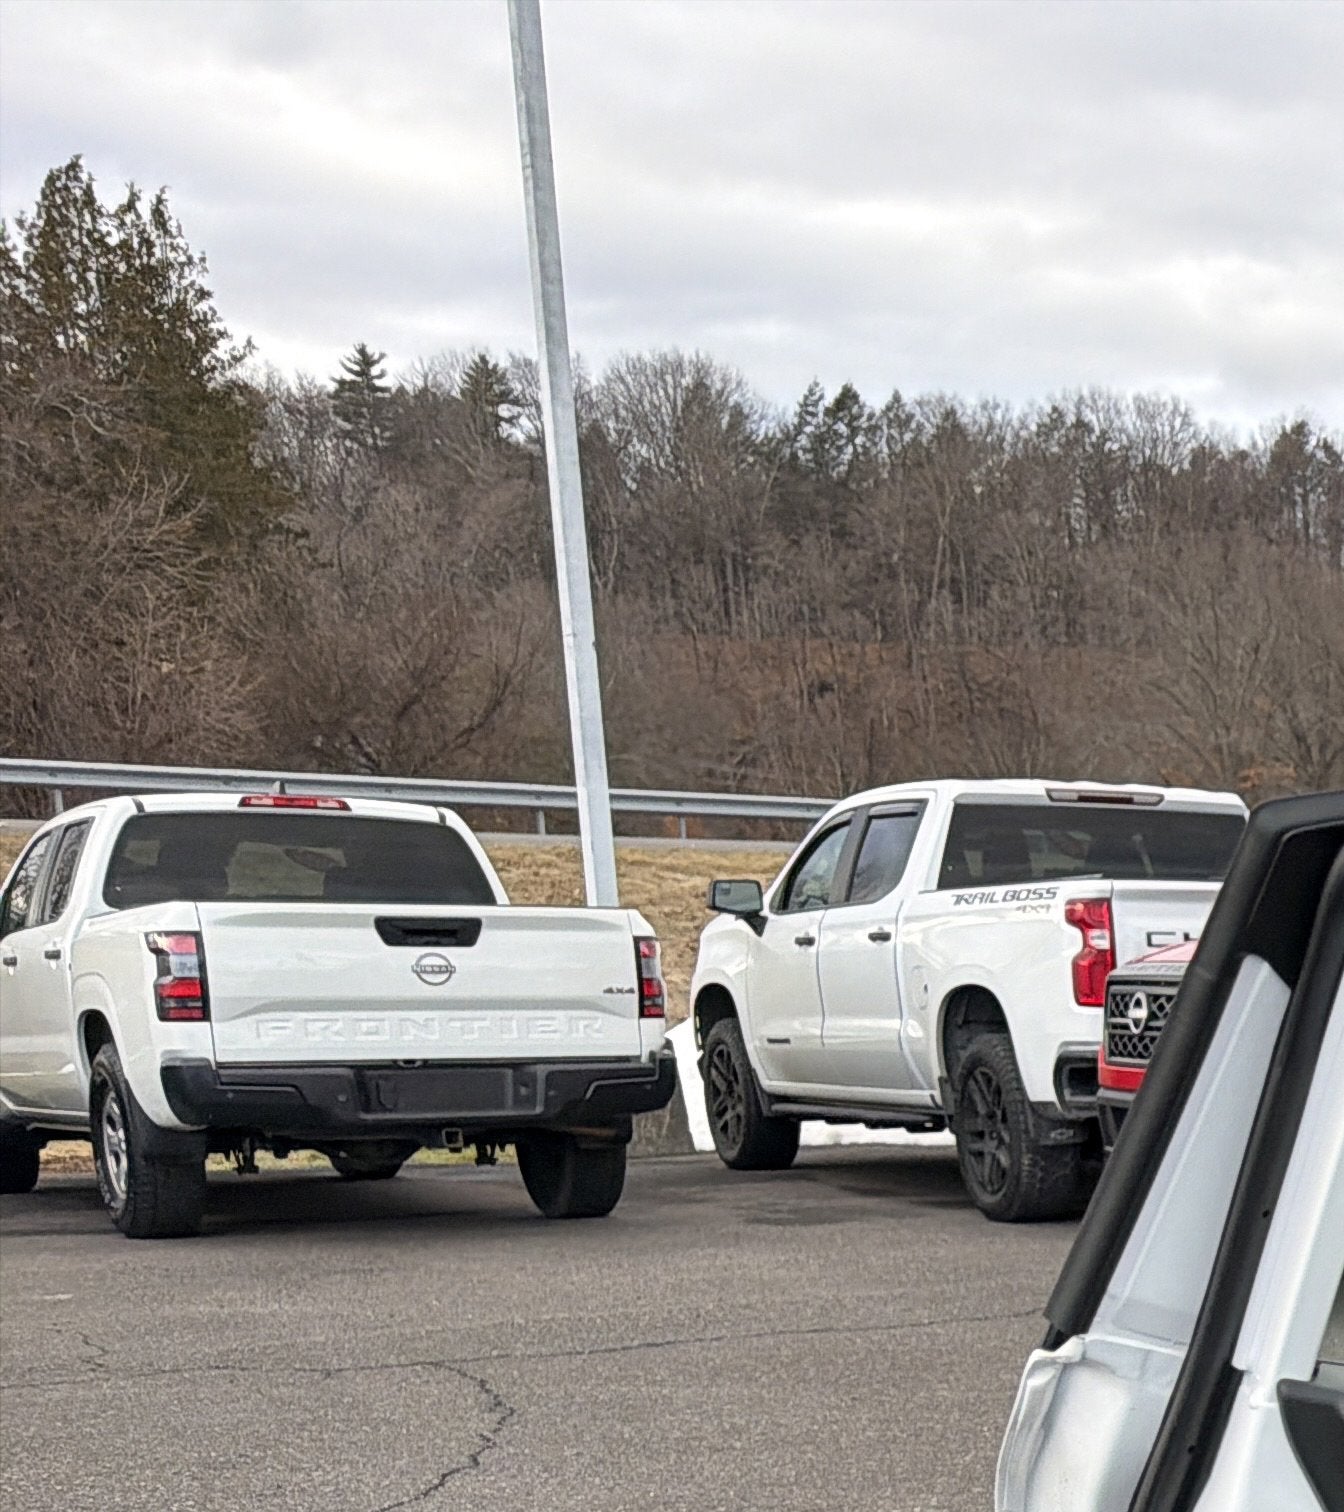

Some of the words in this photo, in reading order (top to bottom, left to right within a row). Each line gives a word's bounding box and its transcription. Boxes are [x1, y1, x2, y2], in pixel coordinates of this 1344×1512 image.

[951, 891, 1000, 906] TRAIL
[1001, 886, 1060, 902] BOSS
[255, 1016, 605, 1042] FRONTIER
